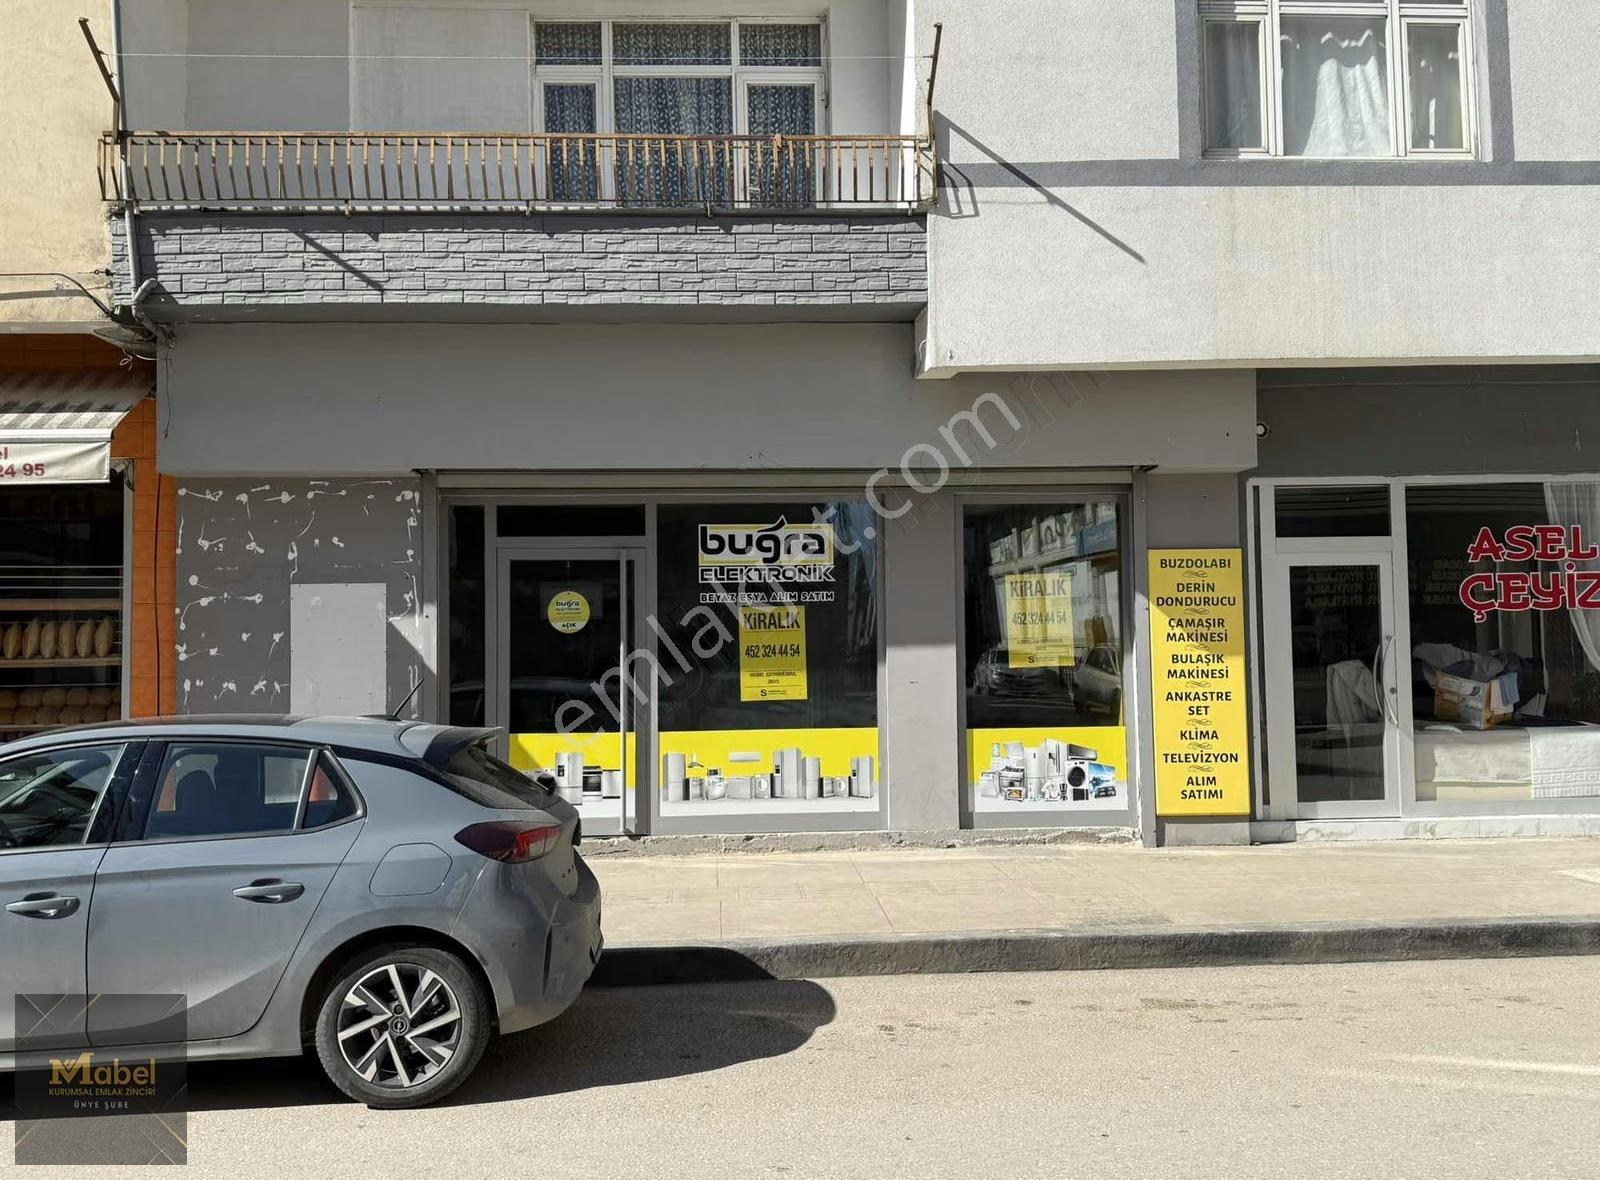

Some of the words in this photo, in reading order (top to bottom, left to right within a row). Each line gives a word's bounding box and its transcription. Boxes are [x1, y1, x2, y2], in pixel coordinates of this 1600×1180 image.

[22, 463, 45, 477] 95
[1467, 525, 1600, 562] ASEL
[1160, 558, 1231, 569] BUZDOLABI
[699, 564, 836, 583] ELEKTRONİK
[1176, 580, 1215, 593] DERİN
[700, 592, 737, 603] BEYAZ
[738, 592, 768, 605] EŞYA
[769, 592, 798, 602] ALIM
[800, 591, 835, 602] SATIM
[1156, 596, 1236, 607] DONDURUCU
[1011, 612, 1027, 626] 452
[1028, 612, 1043, 625] 324
[1056, 611, 1067, 624] 54
[1168, 618, 1225, 630] ÇAMAŞIR
[1166, 629, 1228, 642] MAKİNESİ
[745, 645, 760, 658] 452
[762, 645, 777, 658] 324
[778, 644, 788, 657] 44
[790, 644, 800, 657] 54
[1171, 653, 1225, 666] BULAŞIK
[1167, 665, 1229, 679] MAKİNESİ
[1165, 691, 1232, 702] ANKASTRE
[1188, 706, 1210, 716] SET
[1180, 726, 1219, 740] KLİMA
[1163, 750, 1239, 764] TELEVİZYON
[1186, 776, 1217, 786] ALIM
[1180, 789, 1223, 800] SATIMI
